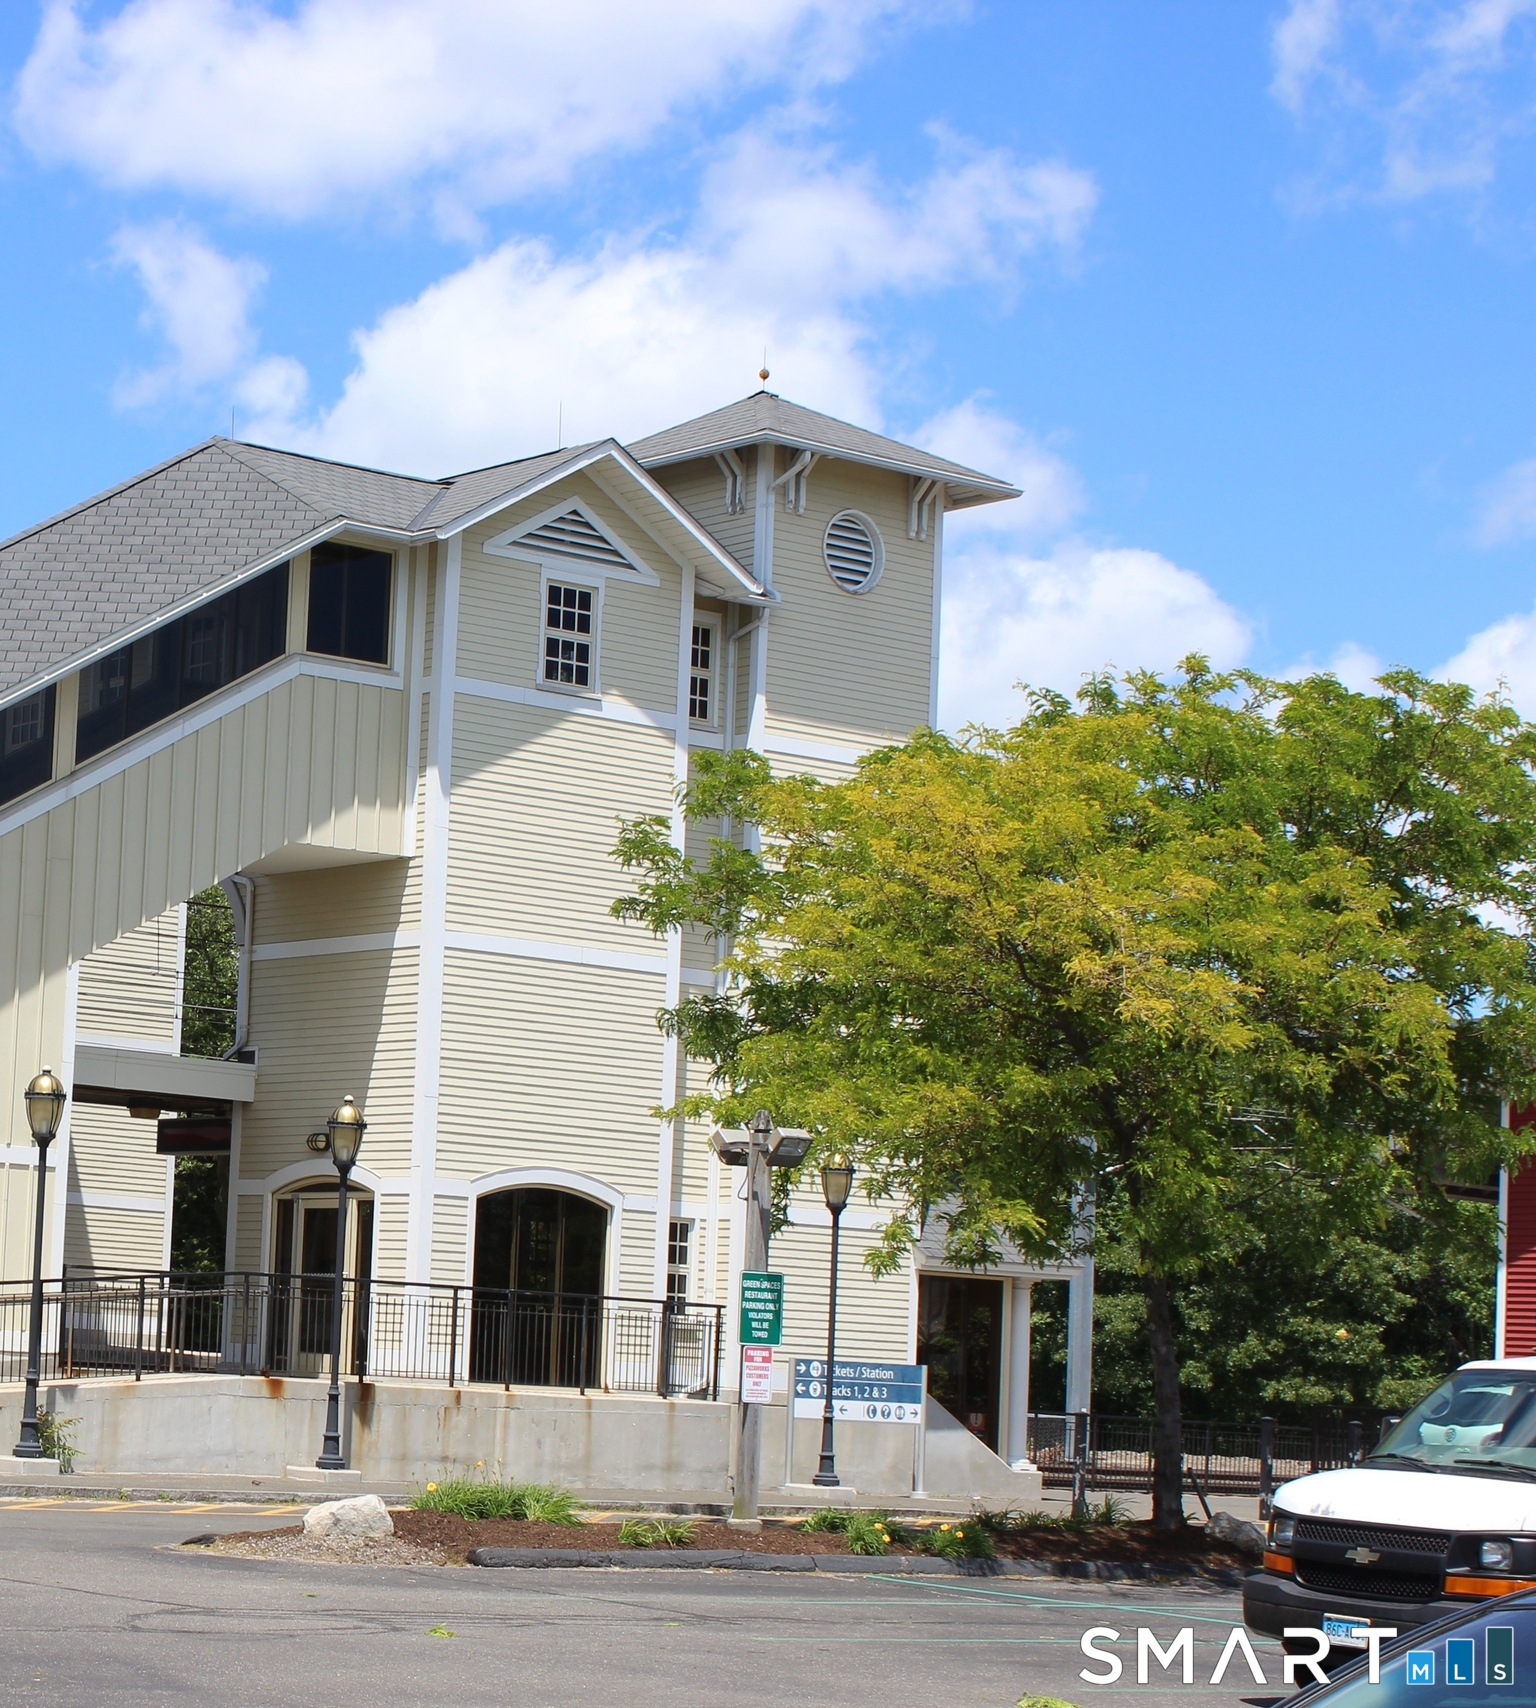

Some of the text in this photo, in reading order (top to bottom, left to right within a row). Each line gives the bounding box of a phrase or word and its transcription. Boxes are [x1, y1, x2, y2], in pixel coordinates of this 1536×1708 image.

[742, 1279, 781, 1290] GREEN SPACES
[745, 1291, 777, 1299] RESTAURANT
[742, 1301, 779, 1311] PARKING ONLY
[751, 1321, 770, 1329] WILL BE
[747, 1349, 770, 1357] PARKING
[823, 1365, 854, 1377] Tkets
[861, 1367, 894, 1380] Station
[822, 1384, 888, 1399] Tacks 1, 2 & 3
